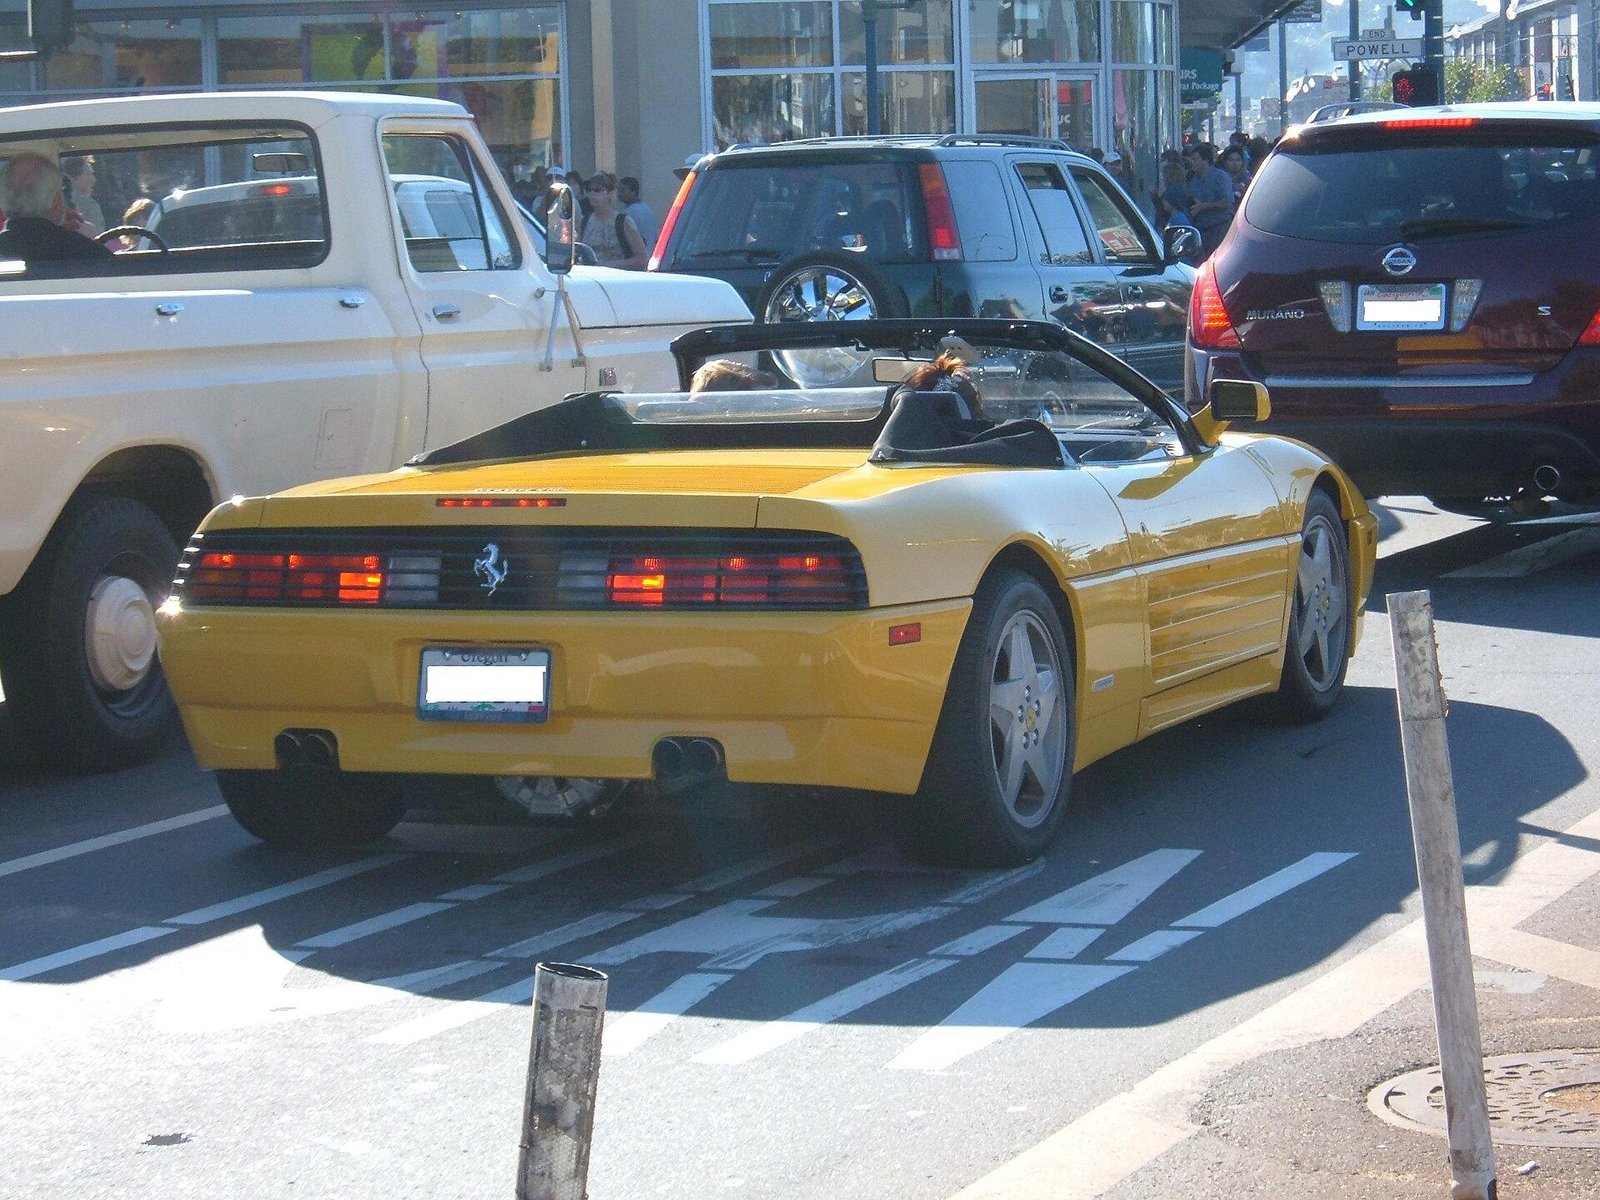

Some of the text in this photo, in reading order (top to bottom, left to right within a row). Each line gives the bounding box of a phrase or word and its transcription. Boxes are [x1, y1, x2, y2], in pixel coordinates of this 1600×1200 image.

[1369, 30, 1386, 38] END
[1346, 43, 1410, 56] POWELL
[1246, 309, 1305, 320] MURANO
[1537, 306, 1551, 316] S
[460, 652, 509, 666] Oregon
